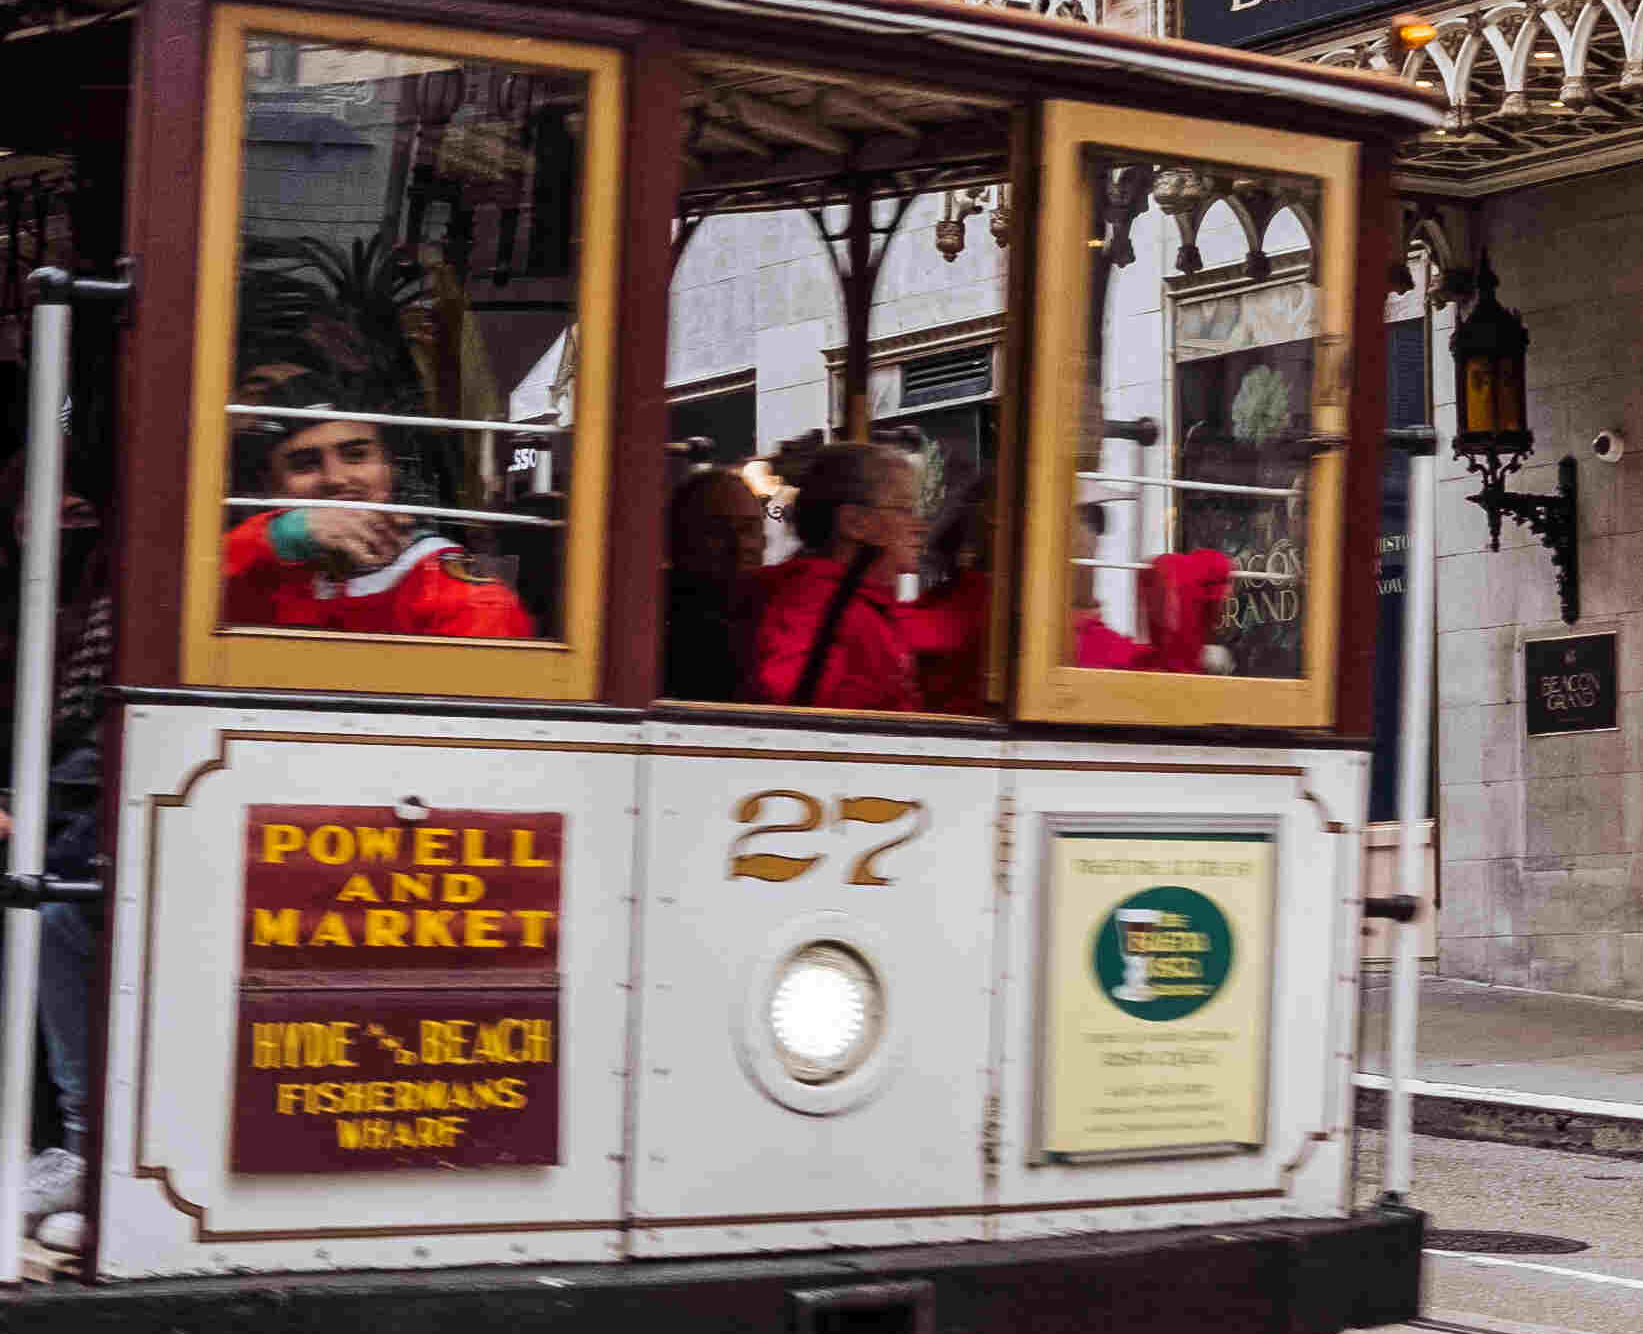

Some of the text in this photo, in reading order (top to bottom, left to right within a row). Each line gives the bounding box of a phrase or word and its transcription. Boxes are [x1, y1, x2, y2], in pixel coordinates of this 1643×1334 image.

[261, 824, 552, 867] POWELL
[726, 788, 930, 886] 27
[336, 872, 486, 903] AND
[252, 908, 554, 947] MARKET
[252, 1021, 360, 1069] HYDE
[419, 1018, 553, 1065] BEACH
[276, 1077, 528, 1115] FISHERMANS
[336, 1116, 470, 1150] WHARF
